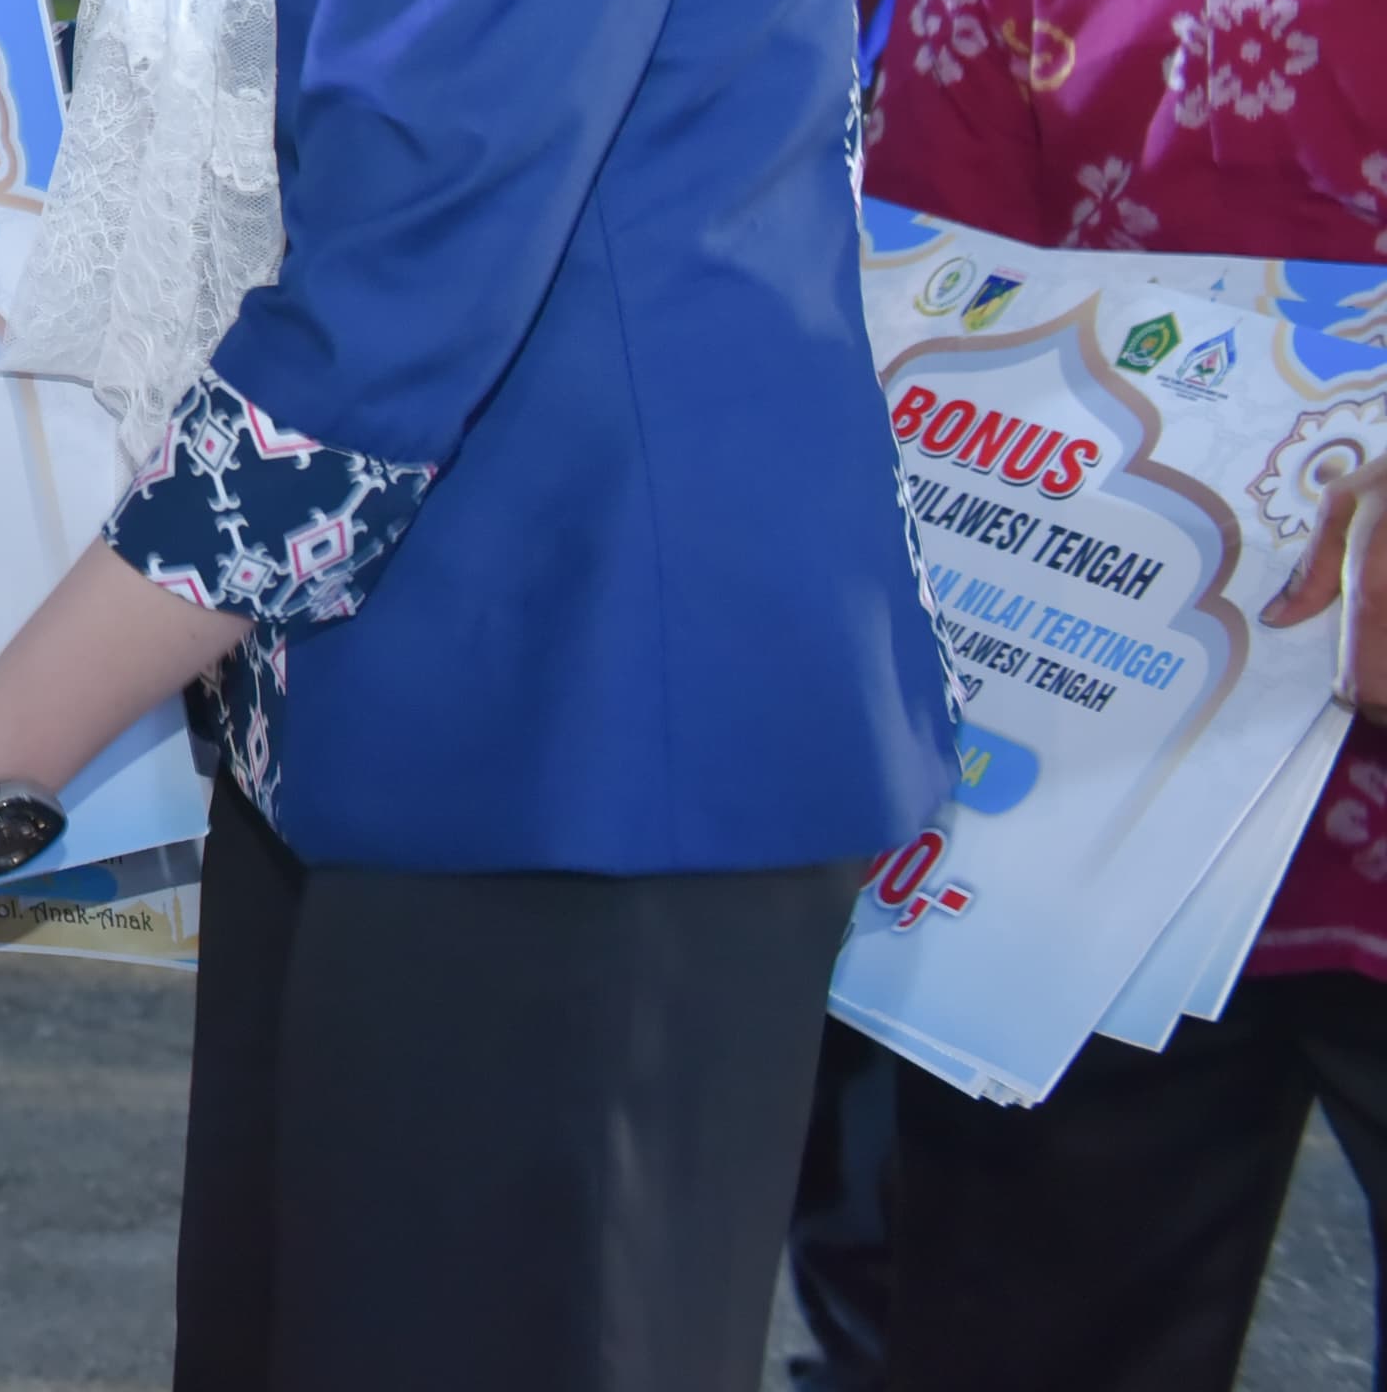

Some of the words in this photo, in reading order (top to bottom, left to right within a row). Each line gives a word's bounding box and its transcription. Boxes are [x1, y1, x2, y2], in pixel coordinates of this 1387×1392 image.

[890, 384, 1101, 498] BONUS
[1032, 524, 1163, 599] TENGAH
[953, 578, 1036, 632] NILAI
[1029, 606, 1184, 690] TERTINGGI
[1025, 656, 1117, 712] TENGAH
[28, 902, 154, 931] Anak-Anak
